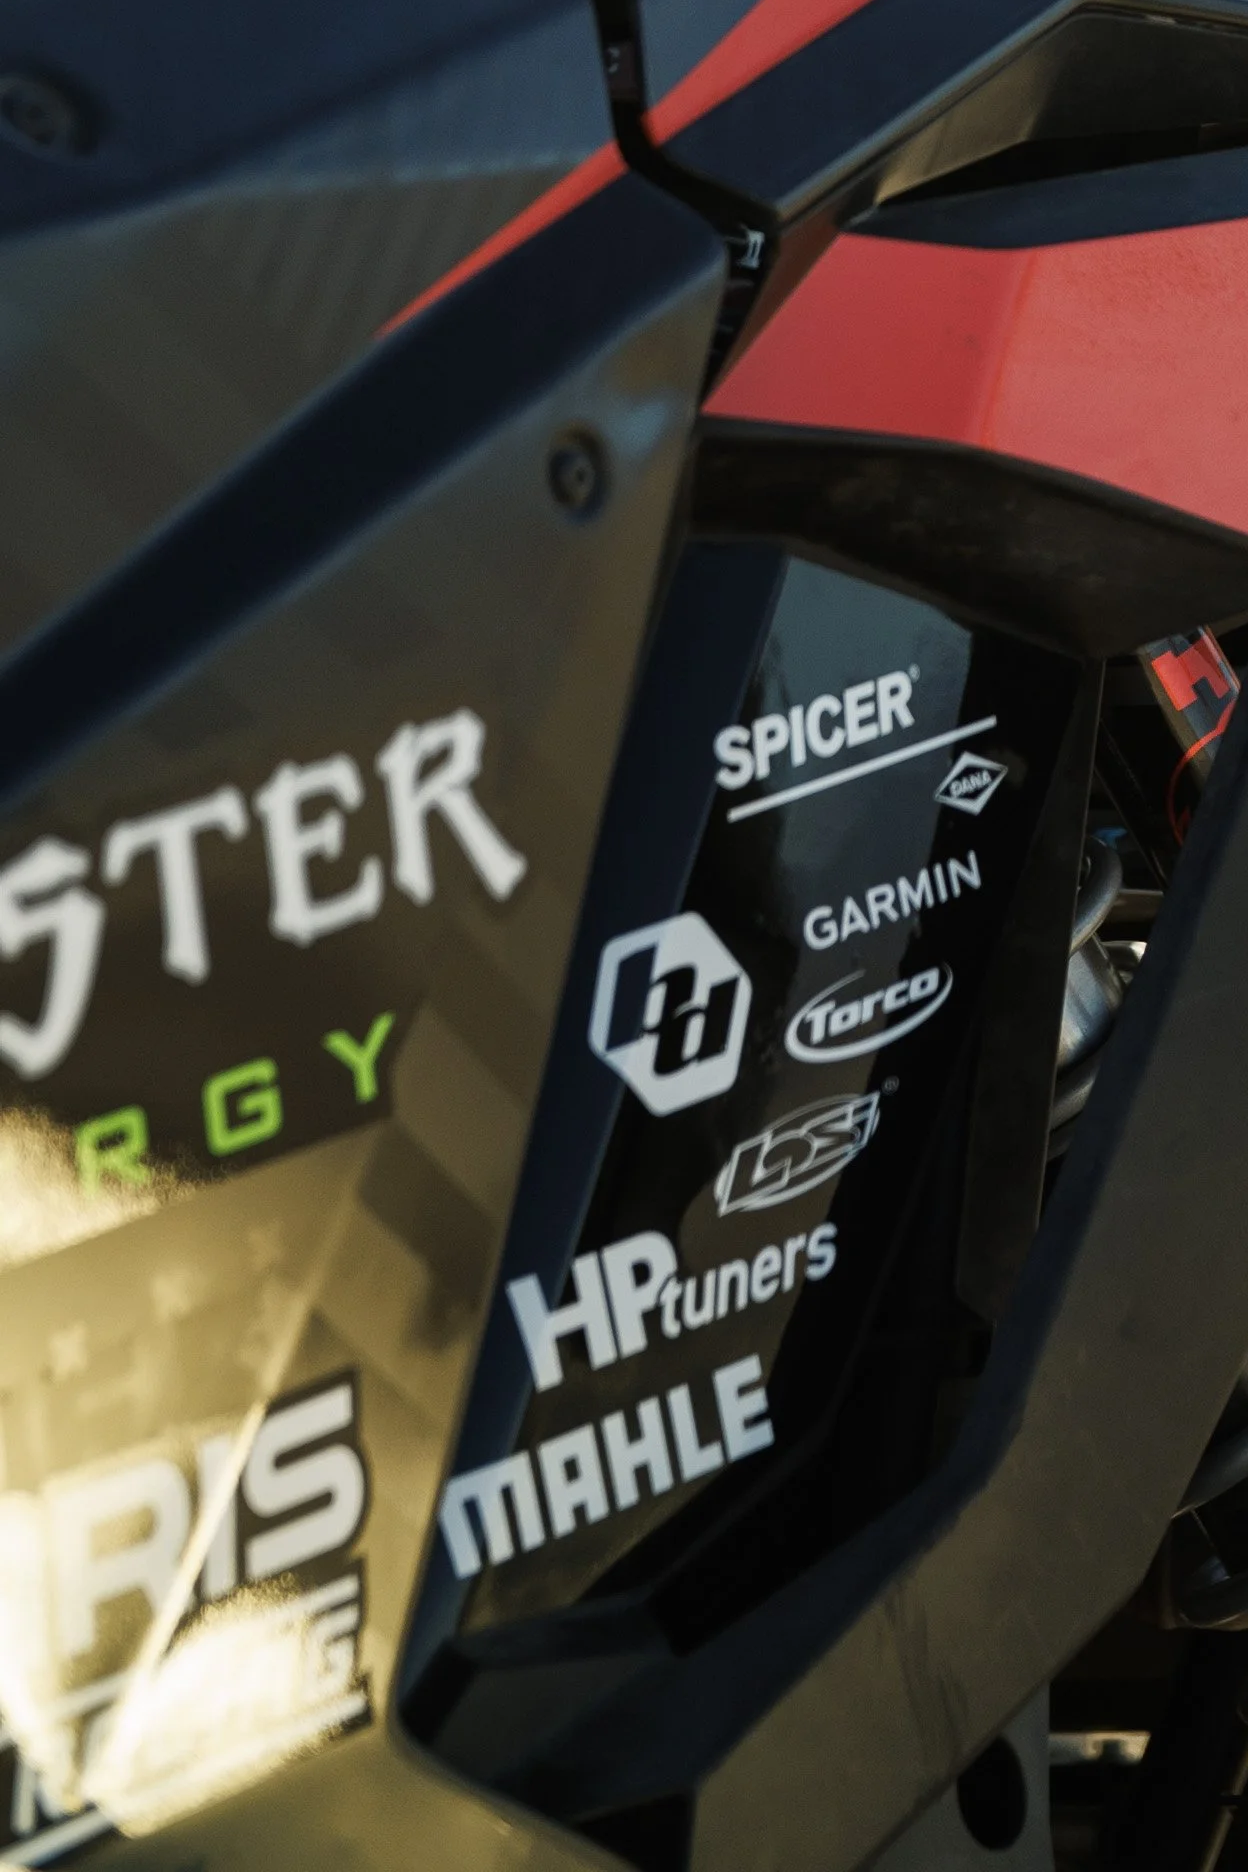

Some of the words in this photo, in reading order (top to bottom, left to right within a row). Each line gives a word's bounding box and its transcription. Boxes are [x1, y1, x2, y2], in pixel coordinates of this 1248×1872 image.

[713, 670, 915, 791] SPICER
[950, 770, 991, 798] DANA
[0, 706, 529, 1080] STER
[803, 850, 982, 950] GARMIN
[437, 1354, 775, 1580] MAHLE
